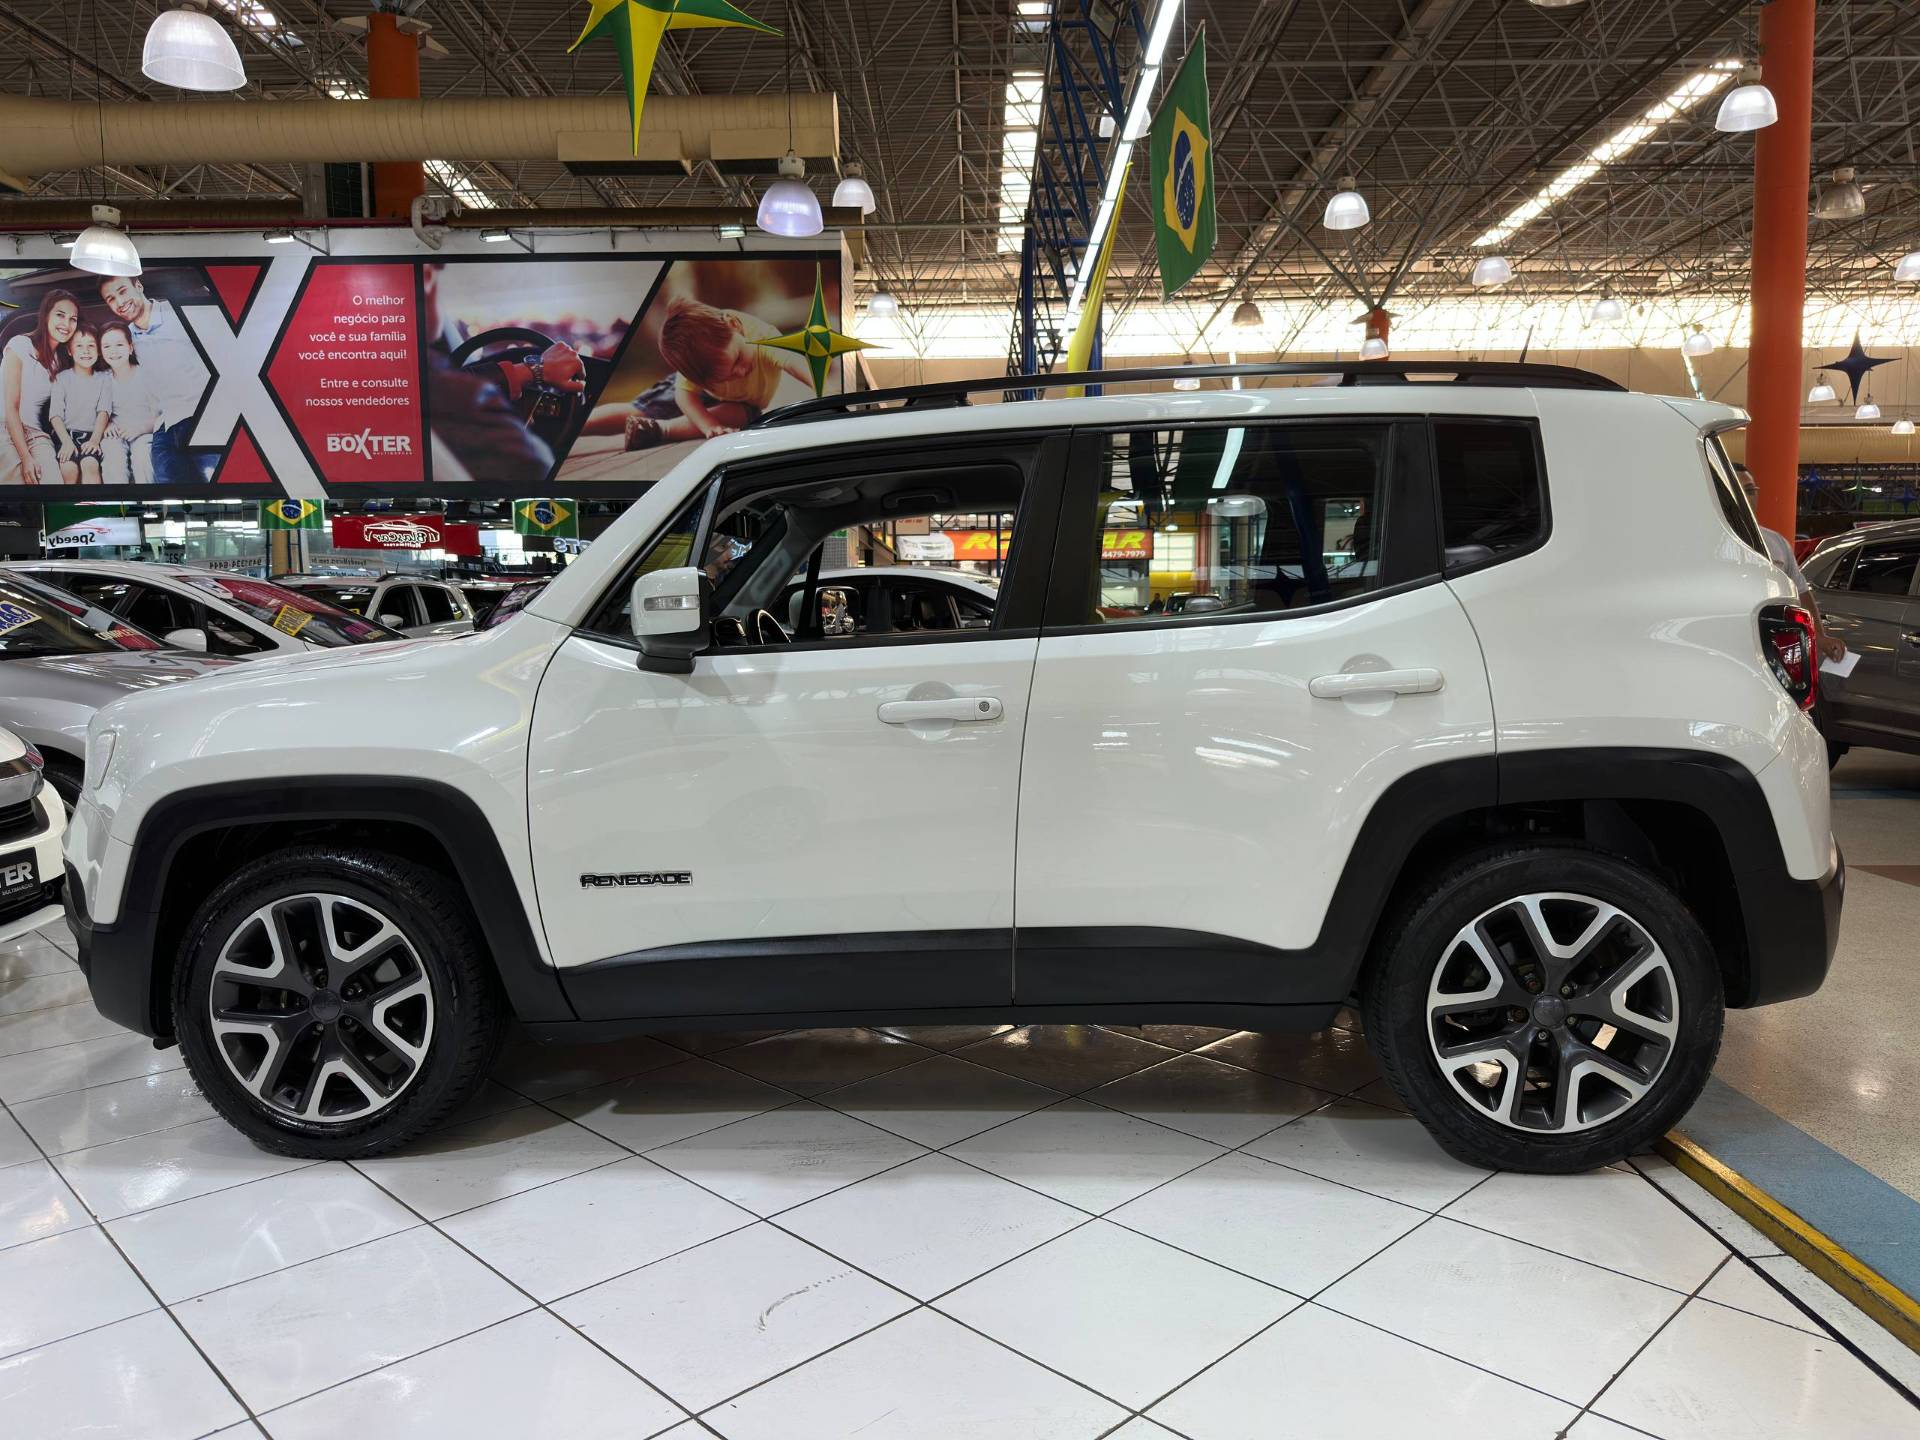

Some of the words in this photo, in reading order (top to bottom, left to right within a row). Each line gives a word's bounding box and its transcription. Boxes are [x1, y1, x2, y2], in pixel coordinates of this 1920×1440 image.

[352, 296, 362, 305] O
[365, 295, 405, 305] melhor
[334, 313, 379, 325] negócio
[382, 314, 406, 325] para
[309, 332, 336, 342] você
[339, 334, 346, 342] e
[348, 334, 367, 342] sua
[370, 331, 406, 342] família
[299, 350, 325, 360] você
[328, 350, 377, 360] encontra
[380, 349, 407, 361] aqui!
[320, 379, 349, 388] Entre
[361, 378, 409, 388] consulte
[306, 398, 343, 406] nossos
[345, 396, 410, 406] vendedores
[327, 428, 411, 460] BOXTER
[580, 871, 691, 887] RENEGADE
